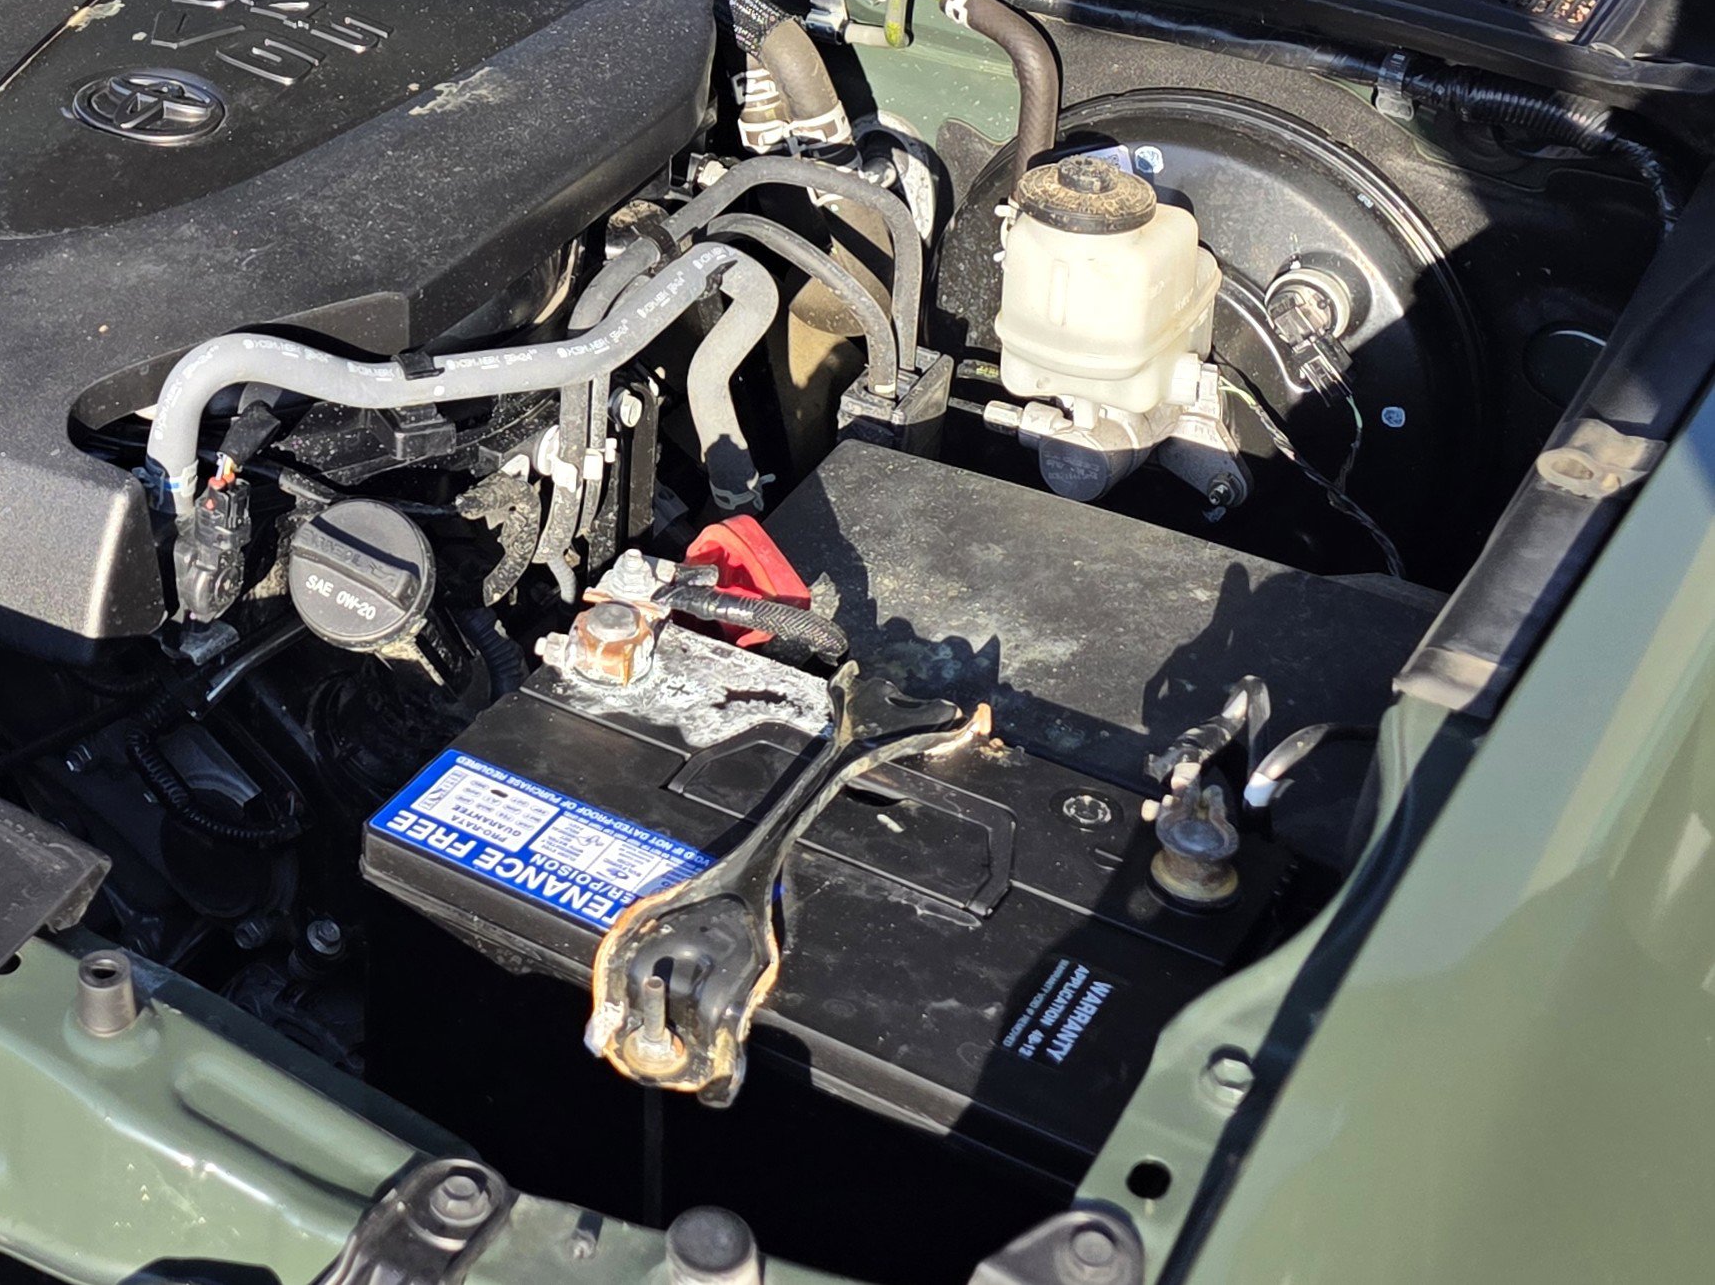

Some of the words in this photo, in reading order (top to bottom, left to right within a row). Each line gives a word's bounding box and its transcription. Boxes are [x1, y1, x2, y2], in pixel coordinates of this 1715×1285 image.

[305, 574, 334, 598] SAE
[336, 590, 377, 621] 0W-20
[456, 756, 507, 780] REQUIRED
[506, 777, 561, 803] PURCHASE
[560, 800, 576, 809] OF
[387, 810, 475, 857] FREE
[451, 815, 506, 842] PRO-RATA
[452, 804, 521, 836] GUARANTEE
[576, 807, 649, 839] DATED-PROOF
[648, 837, 672, 850] NOT
[685, 850, 711, 866] VOID
[474, 848, 625, 923] TENANCE
[530, 853, 634, 903] ER/POISON
[1041, 958, 1070, 994] WARRANTY
[1028, 992, 1046, 1010] VOID
[1039, 963, 1090, 1027] APPLICATION
[1002, 1013, 1032, 1048] REMOVED
[1046, 981, 1115, 1064] WARRANTY
